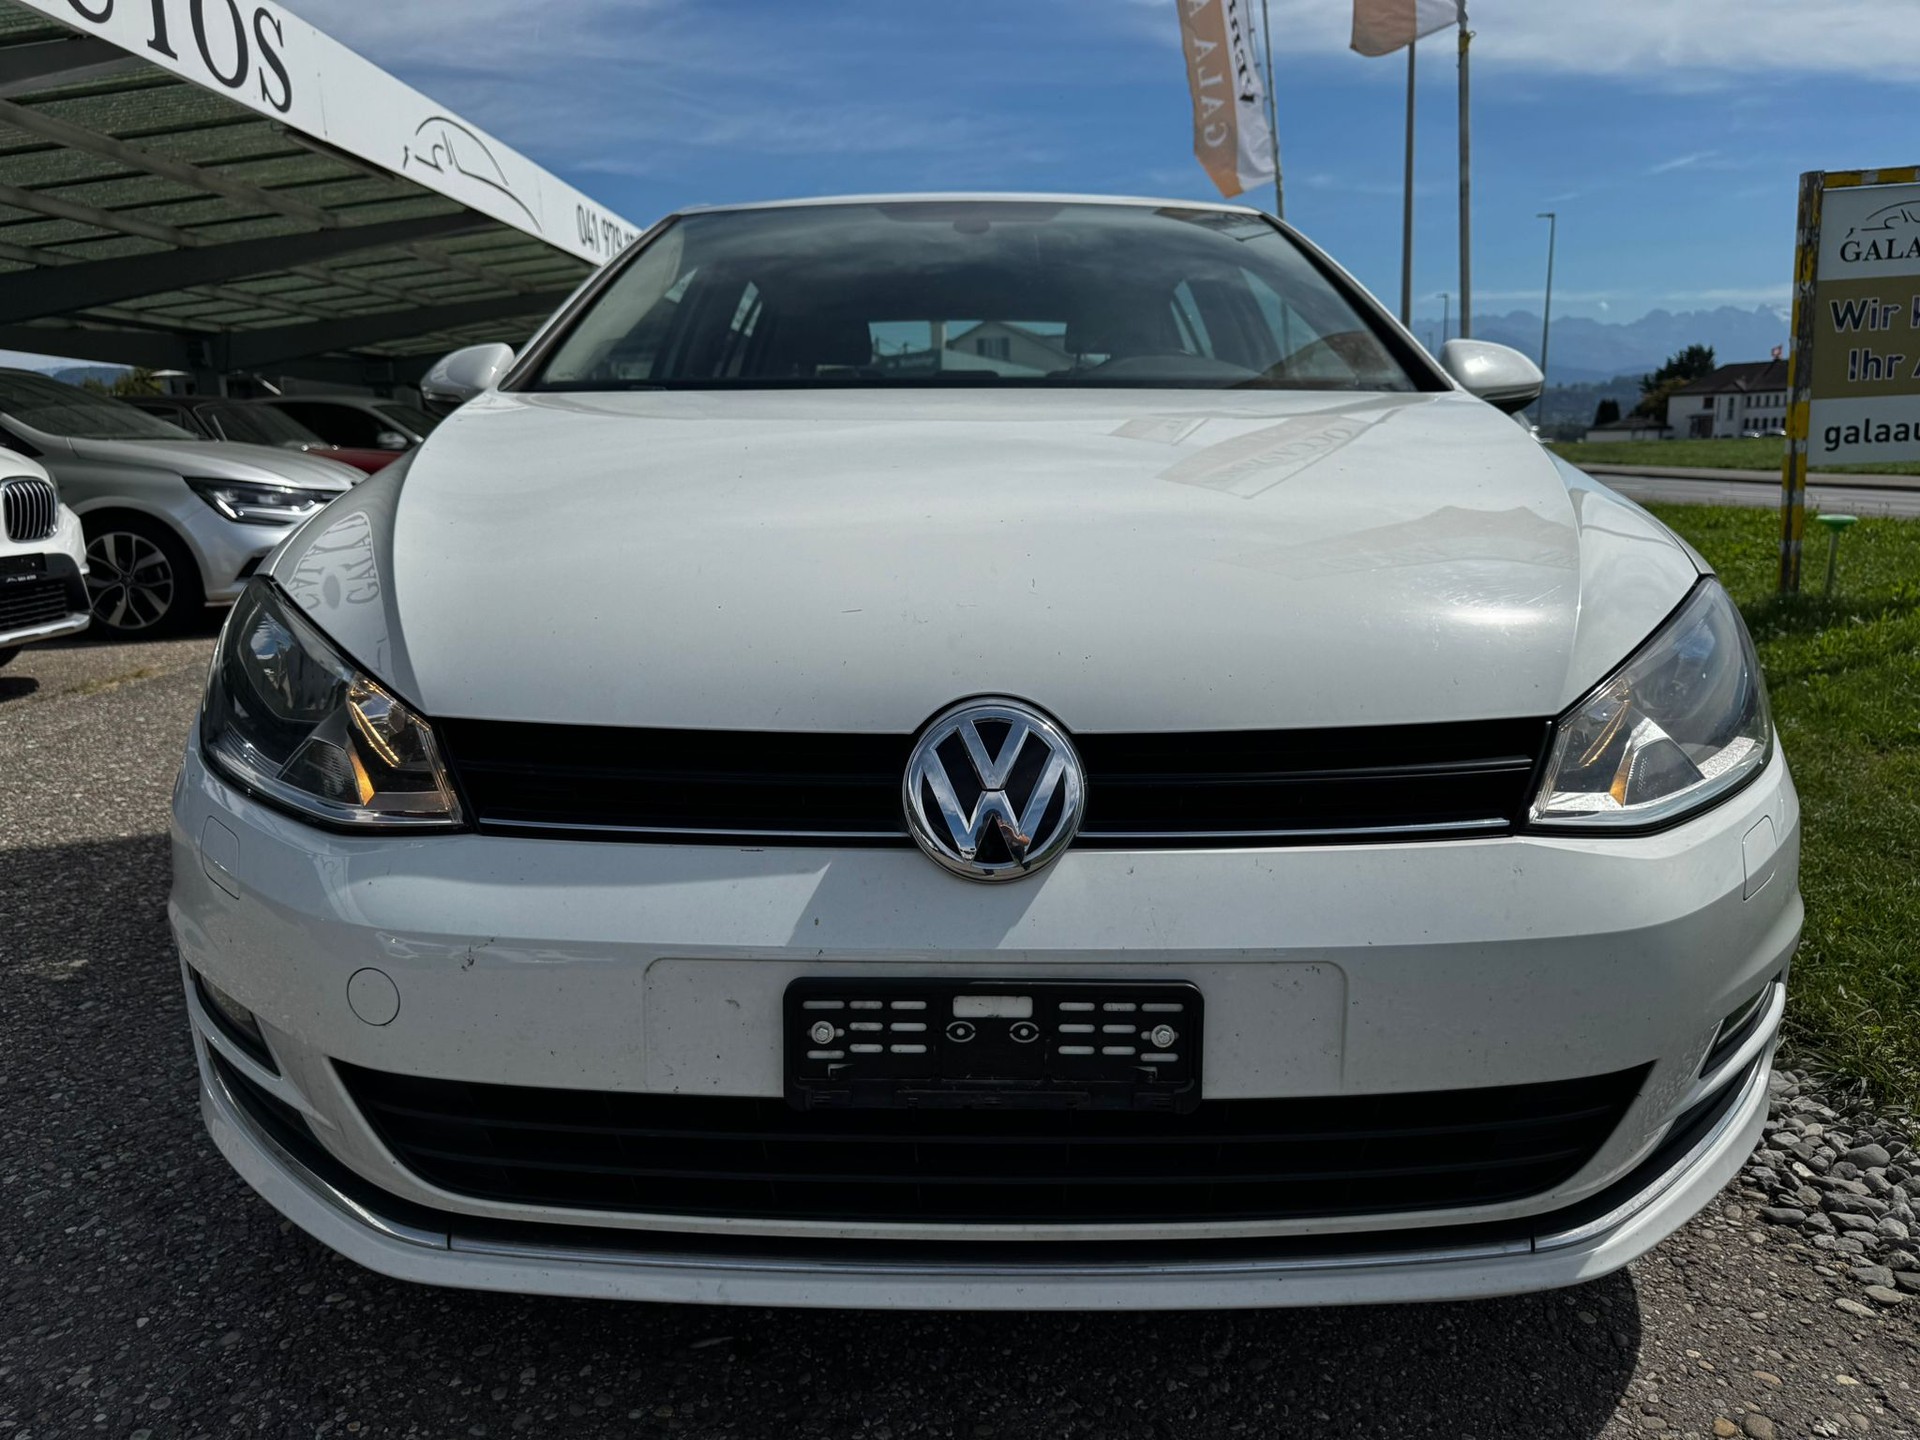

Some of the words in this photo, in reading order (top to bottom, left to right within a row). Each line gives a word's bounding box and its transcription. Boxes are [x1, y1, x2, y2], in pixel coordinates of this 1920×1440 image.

[67, 0, 292, 113] OS
[576, 203, 600, 253] 041
[1829, 297, 1902, 333] Wir
[1847, 347, 1906, 381] Ihr
[911, 703, 1077, 873] VW
